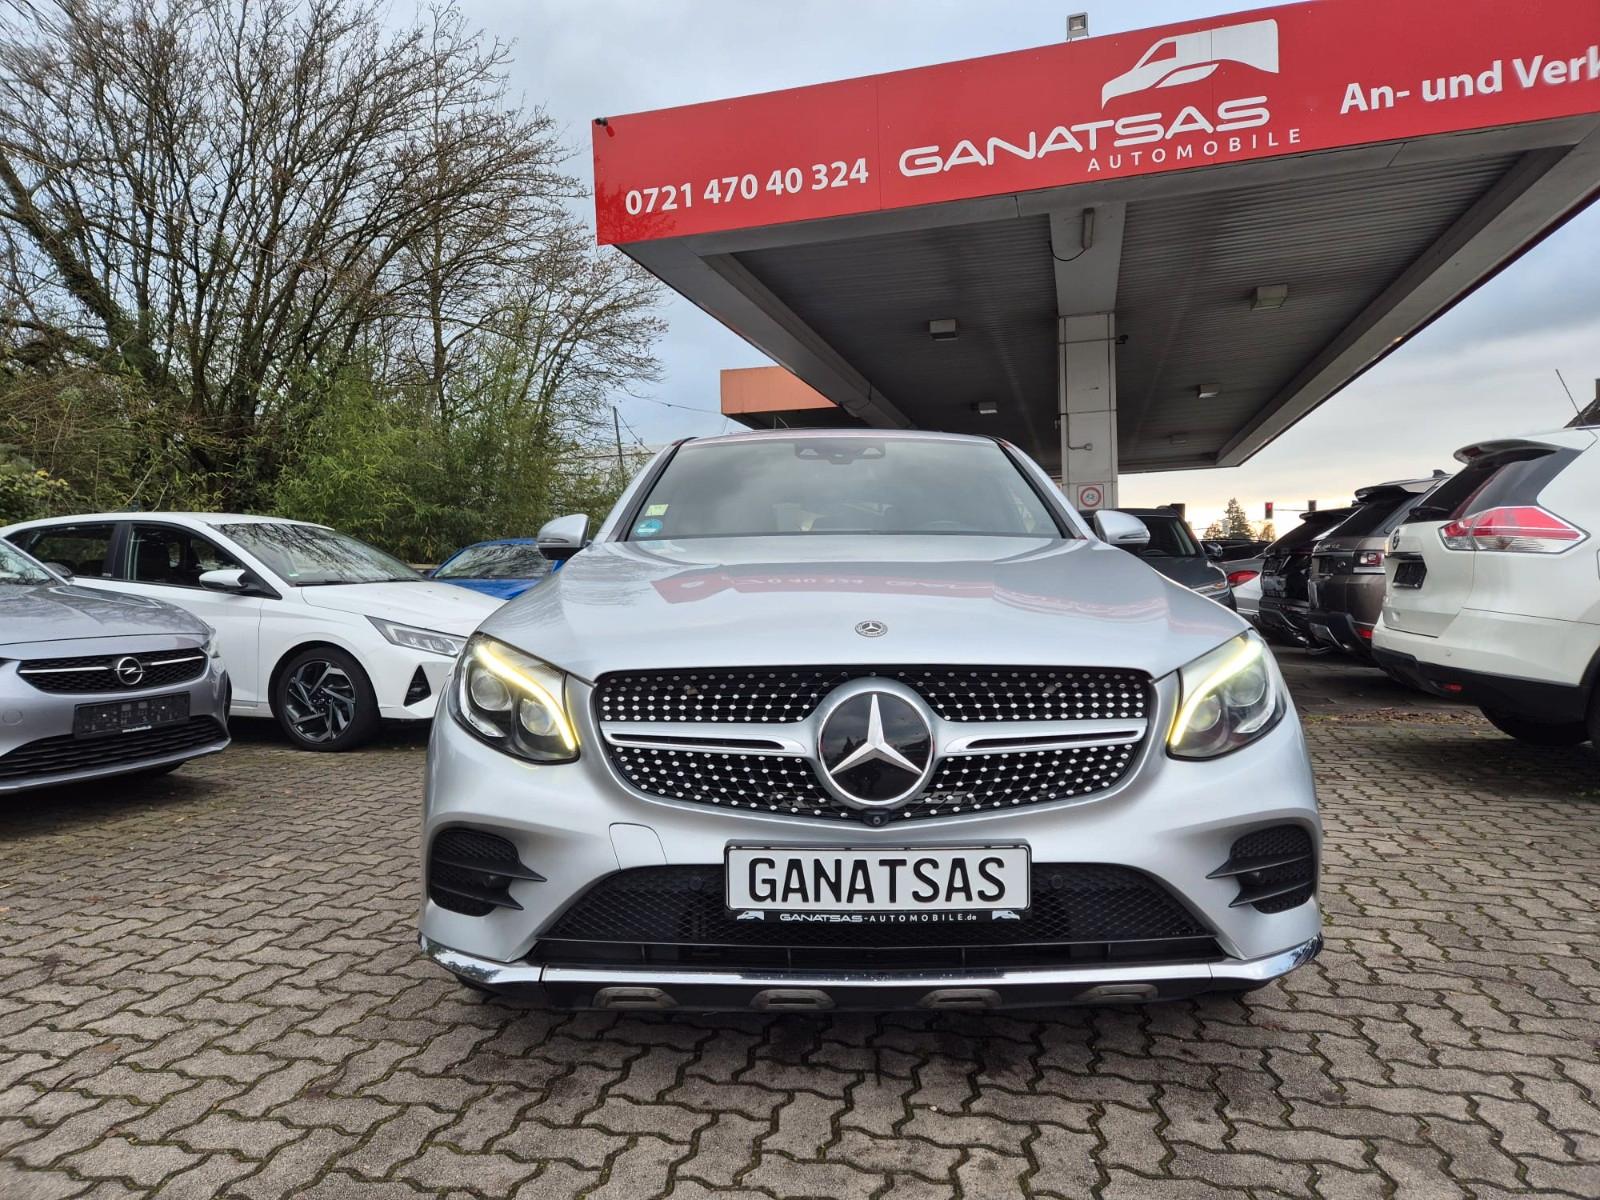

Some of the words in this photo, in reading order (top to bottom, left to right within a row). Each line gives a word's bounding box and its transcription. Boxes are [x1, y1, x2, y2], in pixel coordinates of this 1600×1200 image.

[1340, 82, 1410, 115] An-
[1422, 59, 1503, 102] und
[898, 95, 1270, 177] GANATSAS
[1087, 128, 1301, 173] AUTOMOBILE
[625, 182, 692, 215] 0721
[703, 173, 759, 204] 470
[765, 167, 803, 196] 40
[811, 157, 869, 191] 324
[748, 857, 1006, 904] GANATSAS
